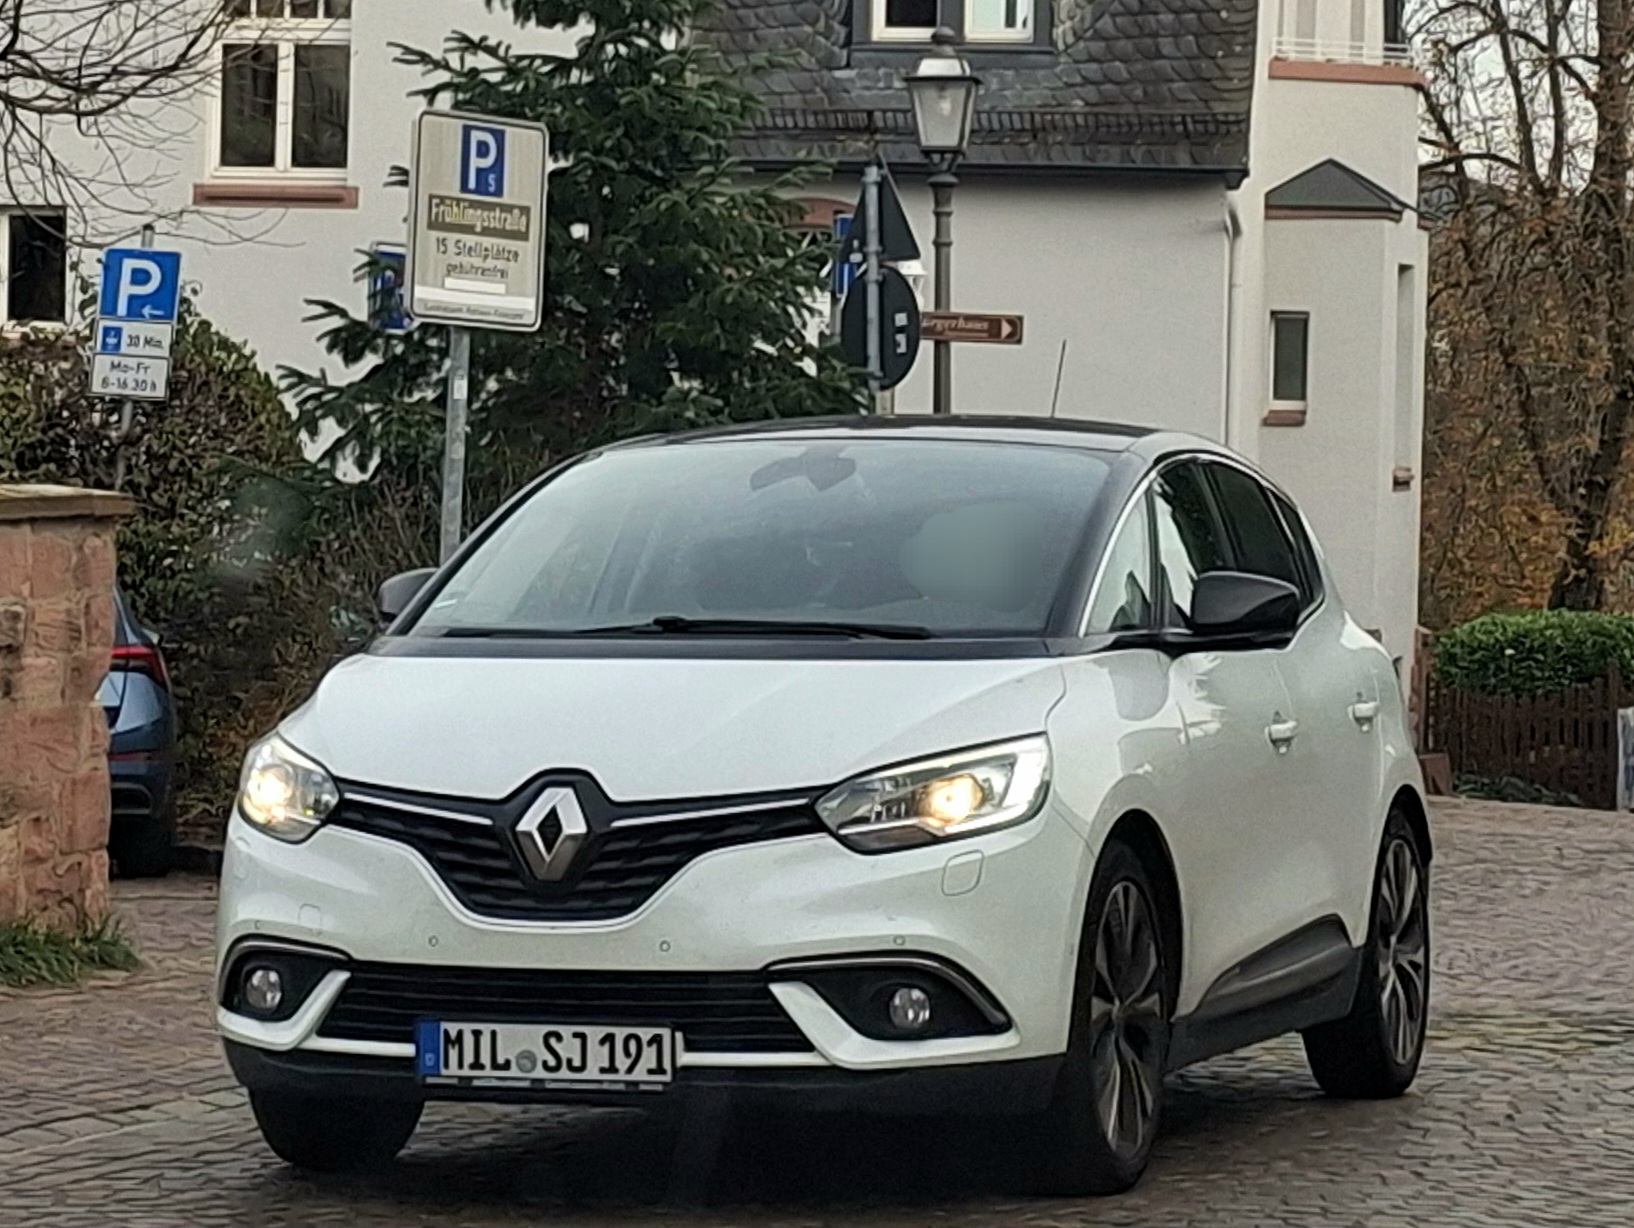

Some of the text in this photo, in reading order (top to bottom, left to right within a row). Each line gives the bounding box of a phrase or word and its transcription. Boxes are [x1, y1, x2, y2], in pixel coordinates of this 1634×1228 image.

[468, 128, 498, 191] P
[431, 198, 527, 233] Frühlingsstraße
[436, 237, 448, 255] 15
[116, 257, 163, 317] P
[109, 360, 151, 375] Mo-Fr
[443, 1028, 668, 1076] MIL SJ 191
